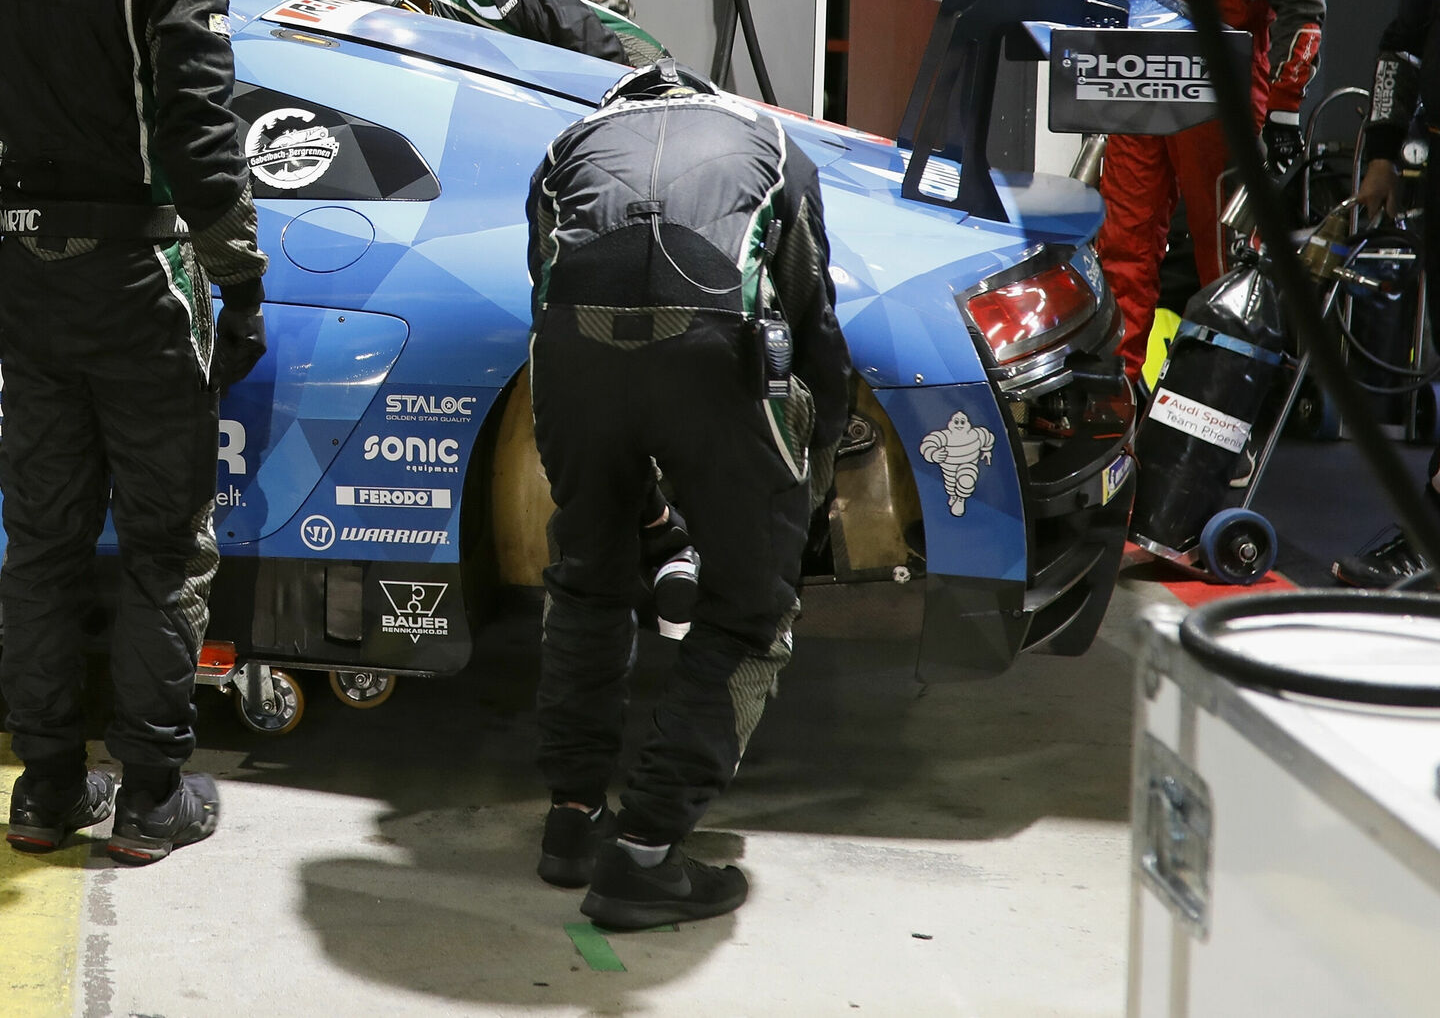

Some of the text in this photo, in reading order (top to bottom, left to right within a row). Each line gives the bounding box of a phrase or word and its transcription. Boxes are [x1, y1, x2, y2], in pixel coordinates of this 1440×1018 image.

[1076, 54, 1210, 79] PHOENI
[250, 147, 331, 167] Gabelbach-Bergrennen
[0, 209, 42, 232] MRTC
[385, 394, 472, 415] STALOC
[385, 414, 417, 422] GOLDEN
[1166, 410, 1198, 432] Team
[1169, 398, 1239, 433] Audi Sport
[405, 464, 459, 474] equipment
[359, 489, 429, 505] FERODO
[381, 615, 448, 629] BAUER
[381, 626, 448, 636] RENNKASKO.DE
